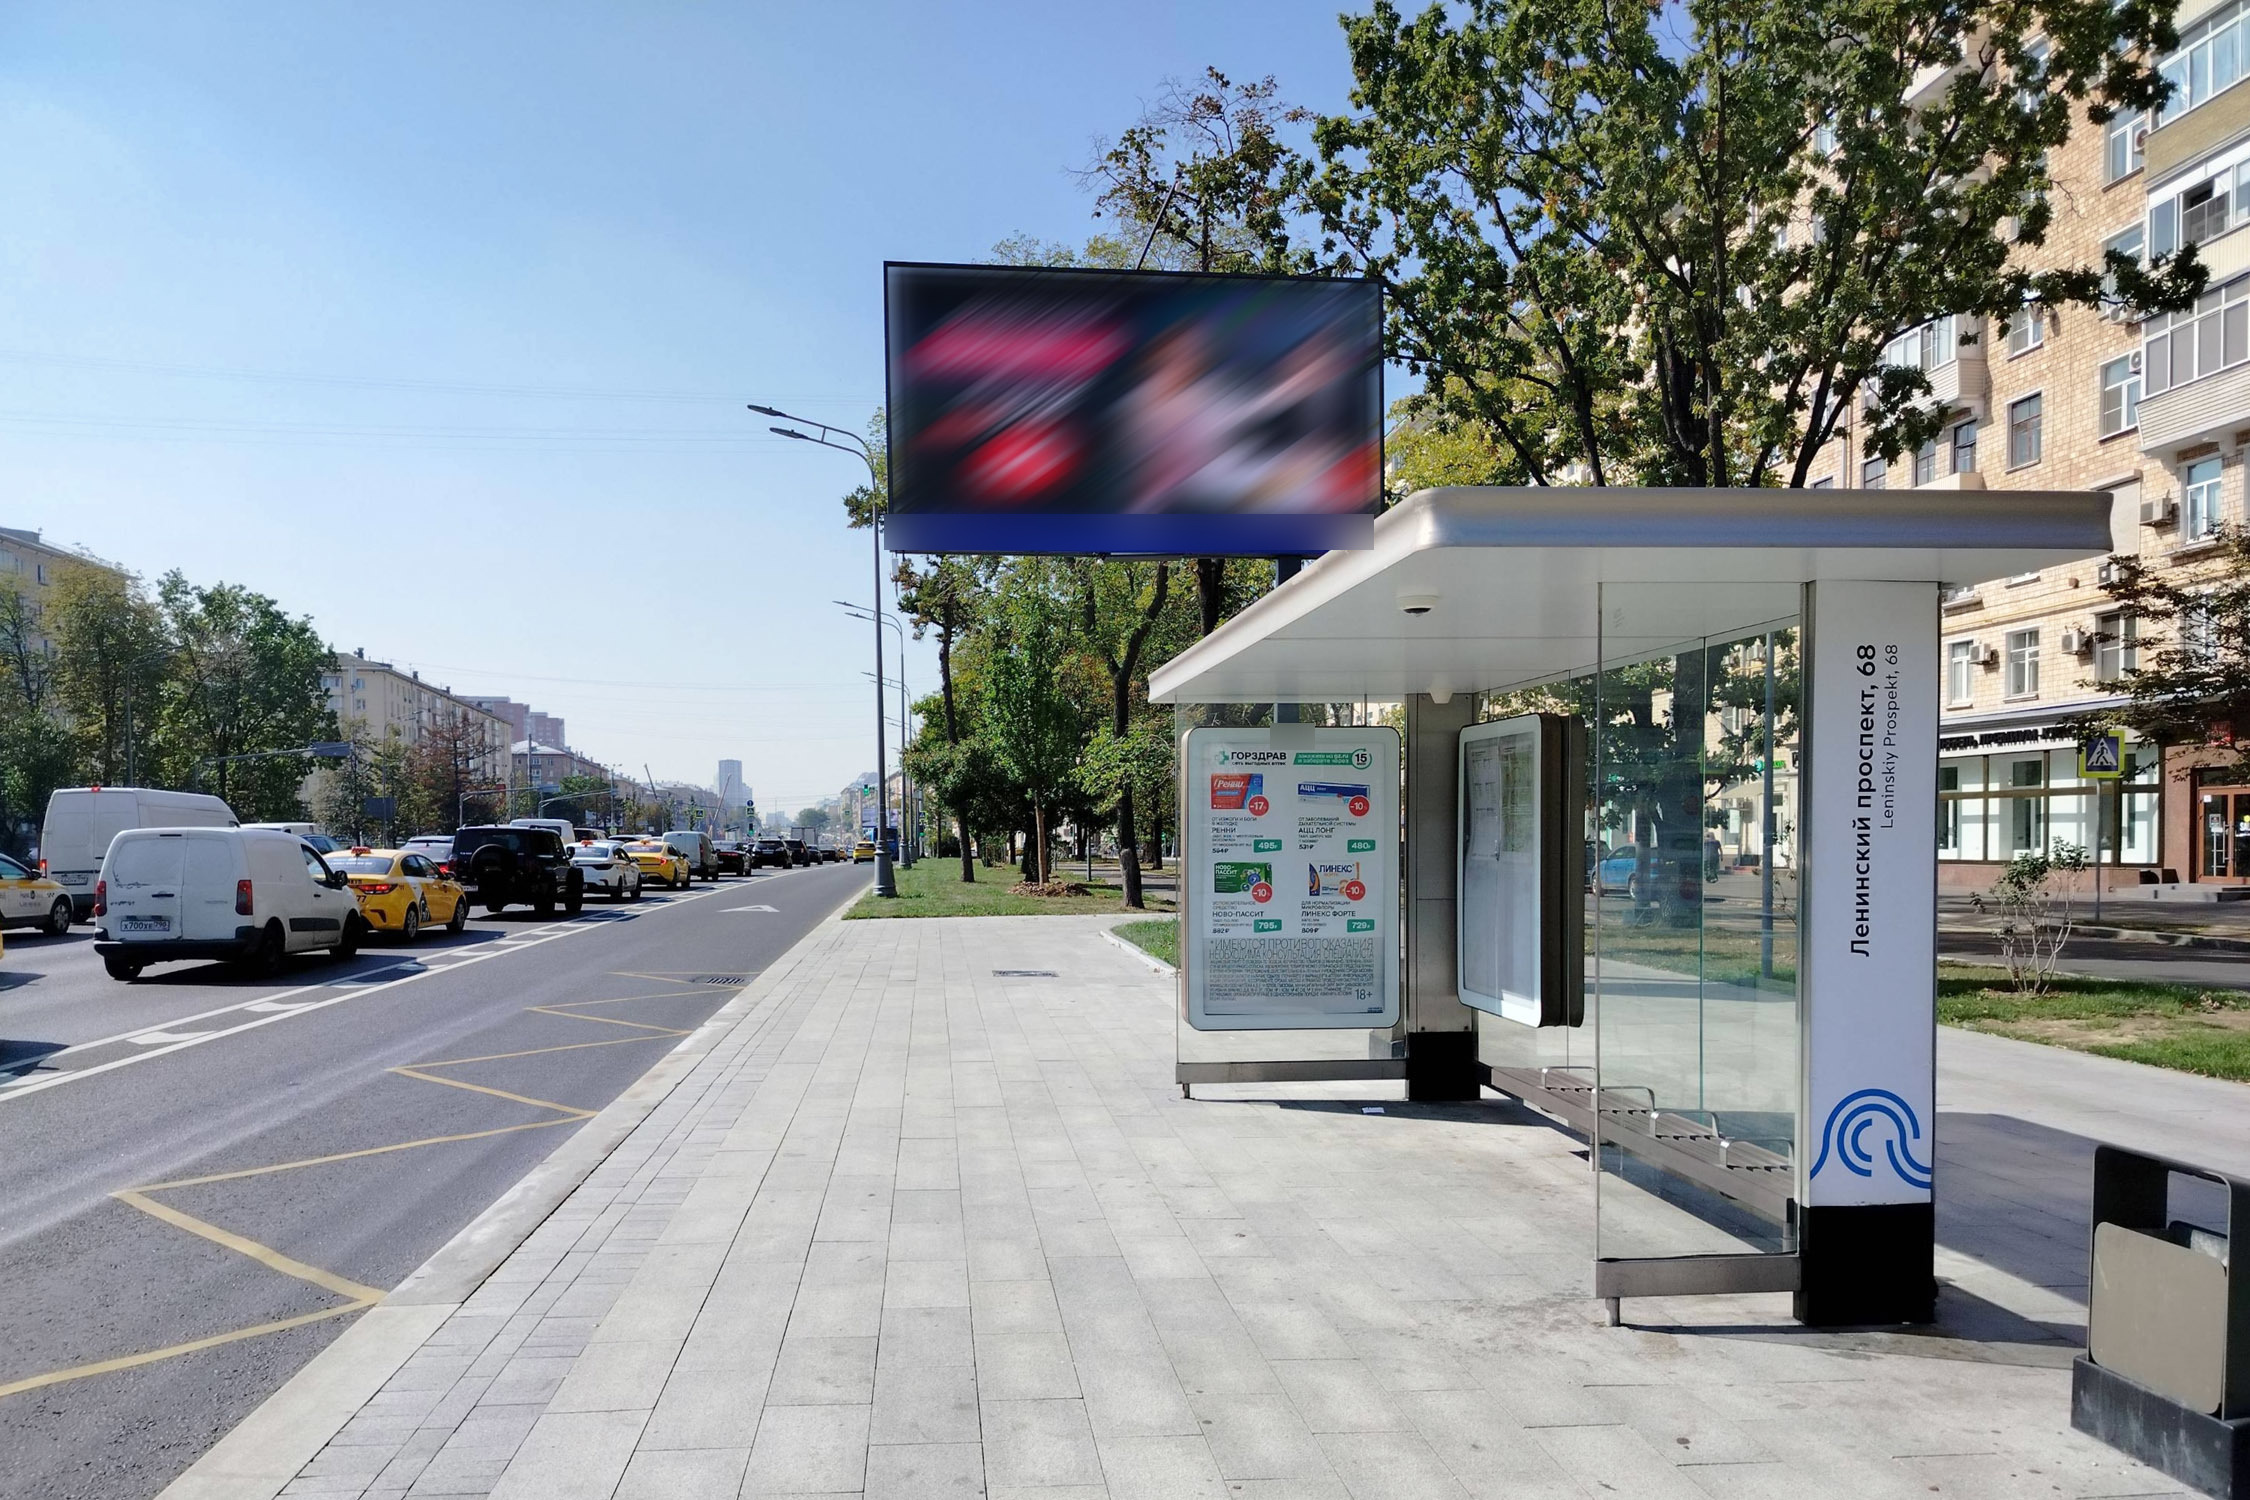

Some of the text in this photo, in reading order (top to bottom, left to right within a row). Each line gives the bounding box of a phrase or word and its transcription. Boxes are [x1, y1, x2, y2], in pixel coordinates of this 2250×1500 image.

[1881, 644, 1899, 828] Leninskiy Prospekt, 68
[1231, 751, 1287, 761] ГОРЗДРАВ
[1355, 753, 1367, 763] 15
[1850, 644, 1878, 957] Ленинский проспект, 68
[1319, 864, 1353, 873] ЛИНЕКС
[1215, 938, 1373, 949] ИМЕЮТСЯ ПРОТИВОПОКАЗАНИЯ
[1209, 949, 1374, 960] НЕОБХОДИМА КОНСУЛЬТАЦИЯ СПЕЦИАЛИСТА
[1355, 989, 1373, 1000] 18+
